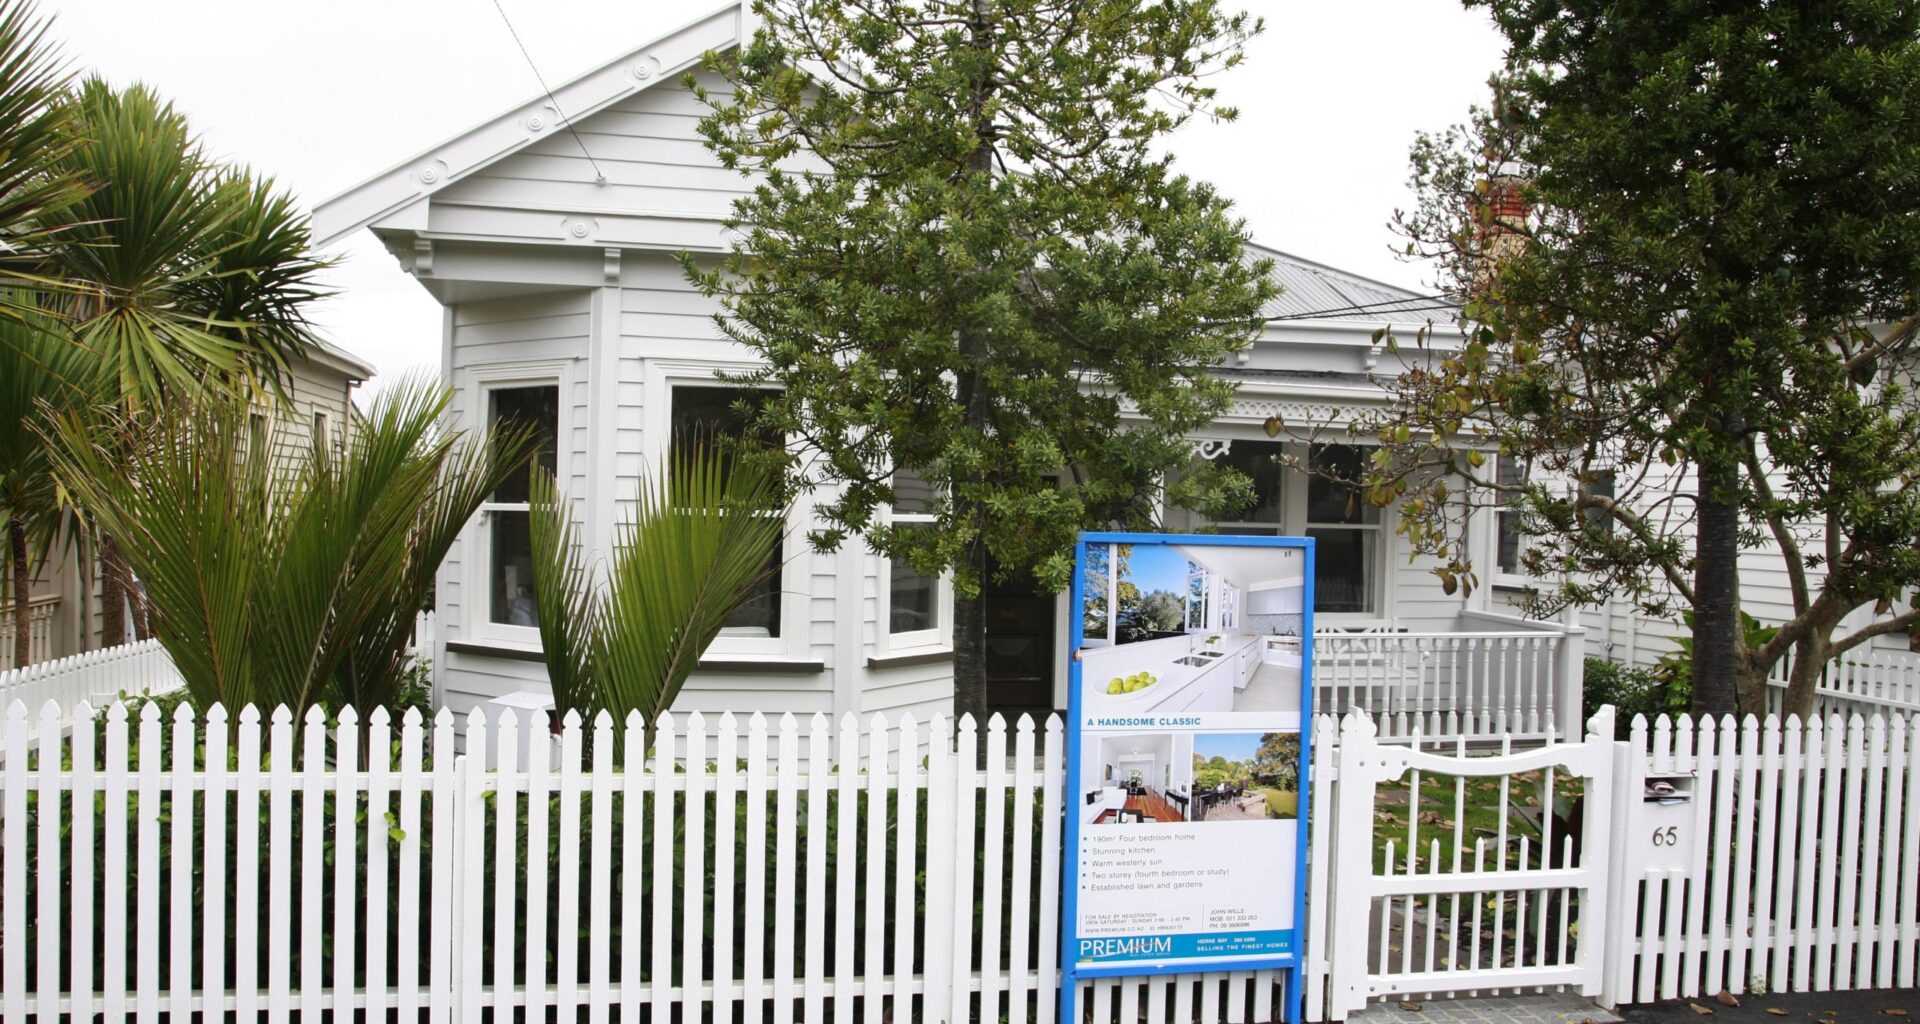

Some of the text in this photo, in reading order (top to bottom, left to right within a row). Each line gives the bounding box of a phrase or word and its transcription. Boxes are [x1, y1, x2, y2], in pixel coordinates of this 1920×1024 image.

[1087, 717, 1201, 726] A HANDSOME CLASSIC
[1119, 834, 1136, 842] Four
[1652, 826, 1678, 846] 65
[1092, 847, 1125, 855] Stunning
[1116, 859, 1146, 867] westerly
[1091, 872, 1106, 880] Two
[1108, 871, 1131, 879] storey
[1134, 870, 1159, 879] (fourth
[1161, 869, 1194, 877] bedroom
[1207, 867, 1229, 876] study)
[1091, 881, 1203, 892] Established lawn and gardens
[1080, 936, 1171, 956] PREMIUM
